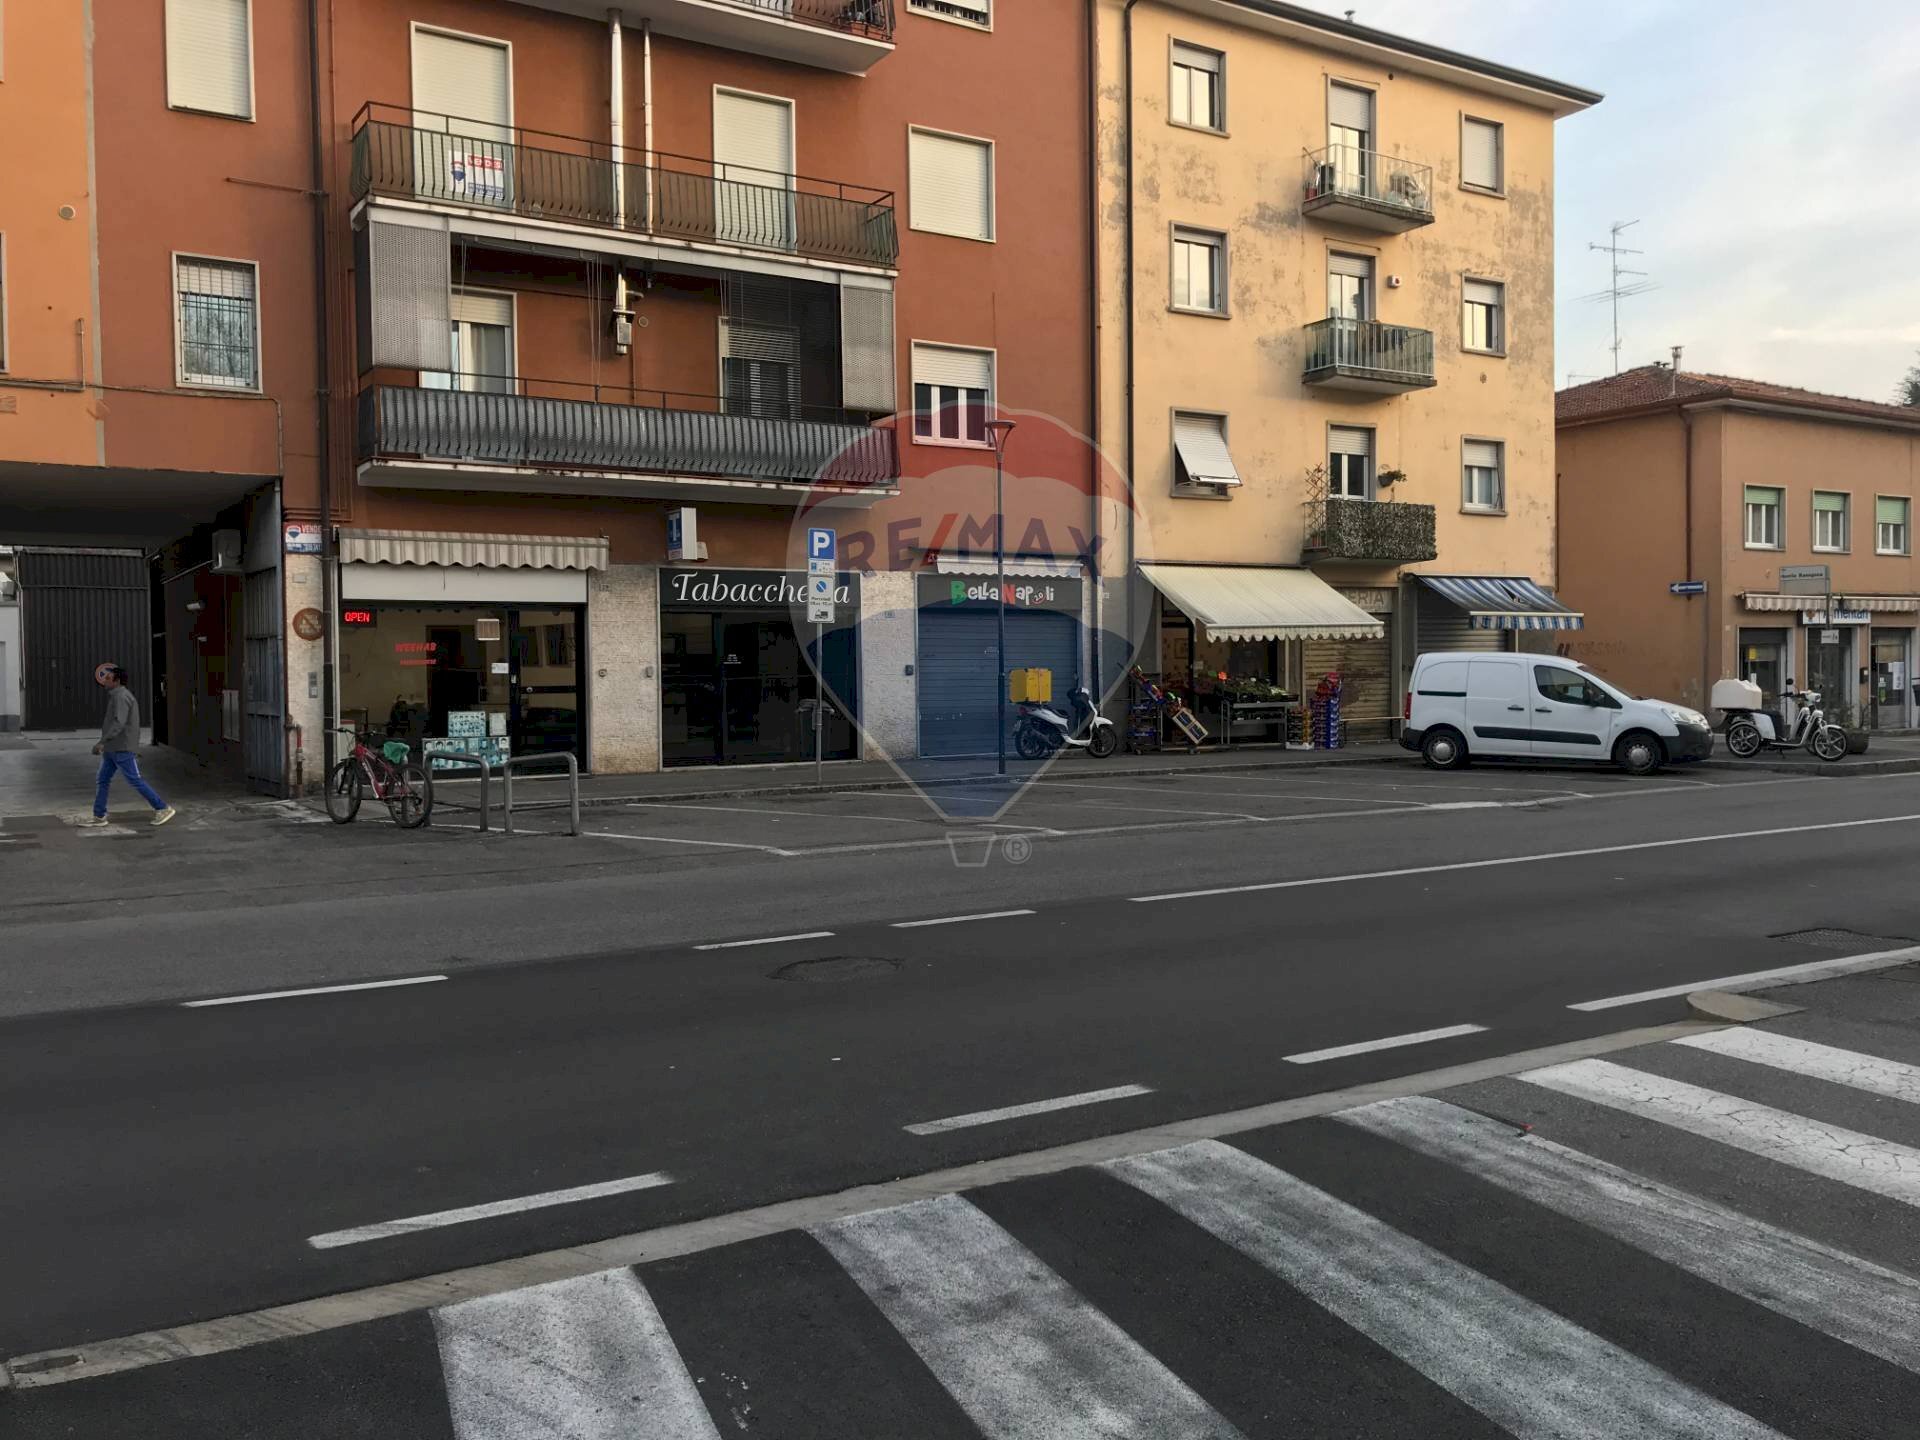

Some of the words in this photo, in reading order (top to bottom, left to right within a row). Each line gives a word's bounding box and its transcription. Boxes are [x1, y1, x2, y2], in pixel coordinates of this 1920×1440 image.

[813, 531, 830, 556] P
[672, 571, 850, 604] Tabacchea
[344, 611, 370, 622] OPEN
